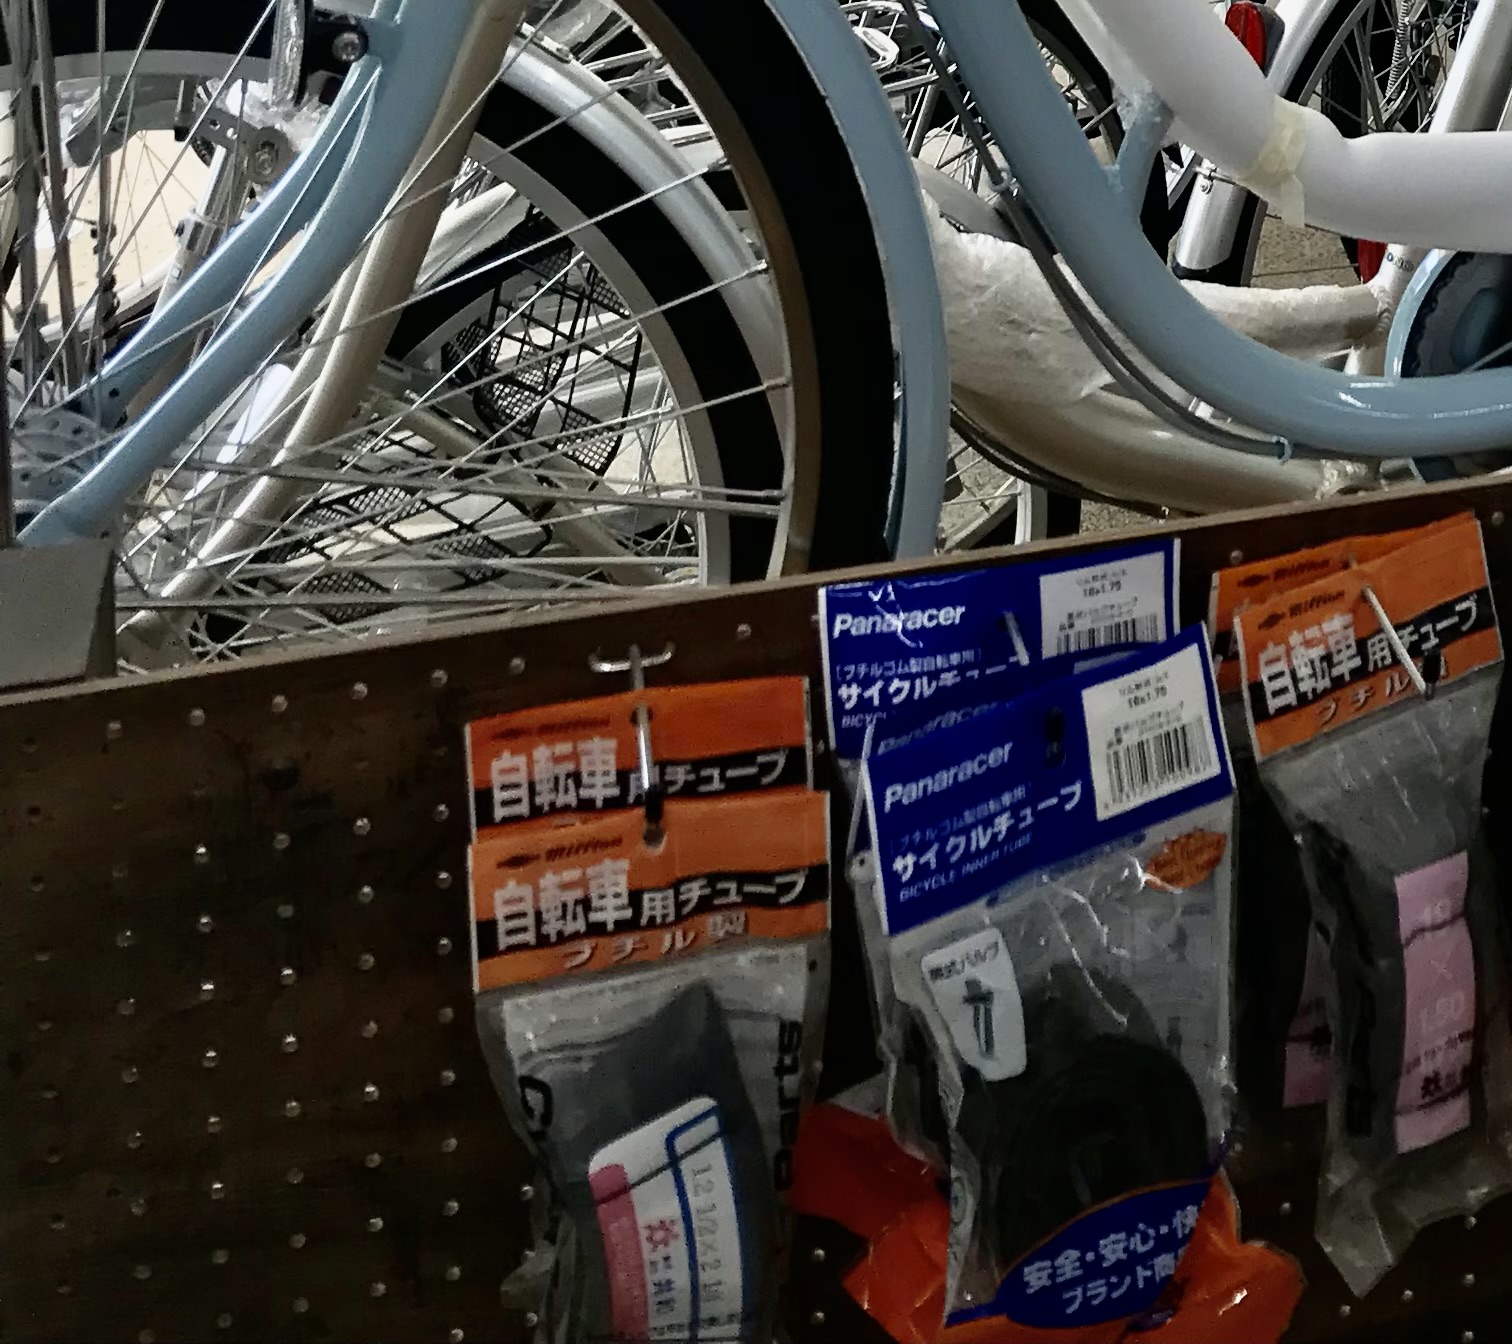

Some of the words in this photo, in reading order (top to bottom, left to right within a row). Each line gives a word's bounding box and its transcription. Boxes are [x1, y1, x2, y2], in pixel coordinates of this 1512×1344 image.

[833, 604, 966, 640] Panaracer
[884, 742, 1013, 813] Panaracer
[893, 778, 1083, 885] サイクルチューブ
[494, 858, 808, 952] 自転車用チューブ
[900, 869, 957, 902] BICYCLE
